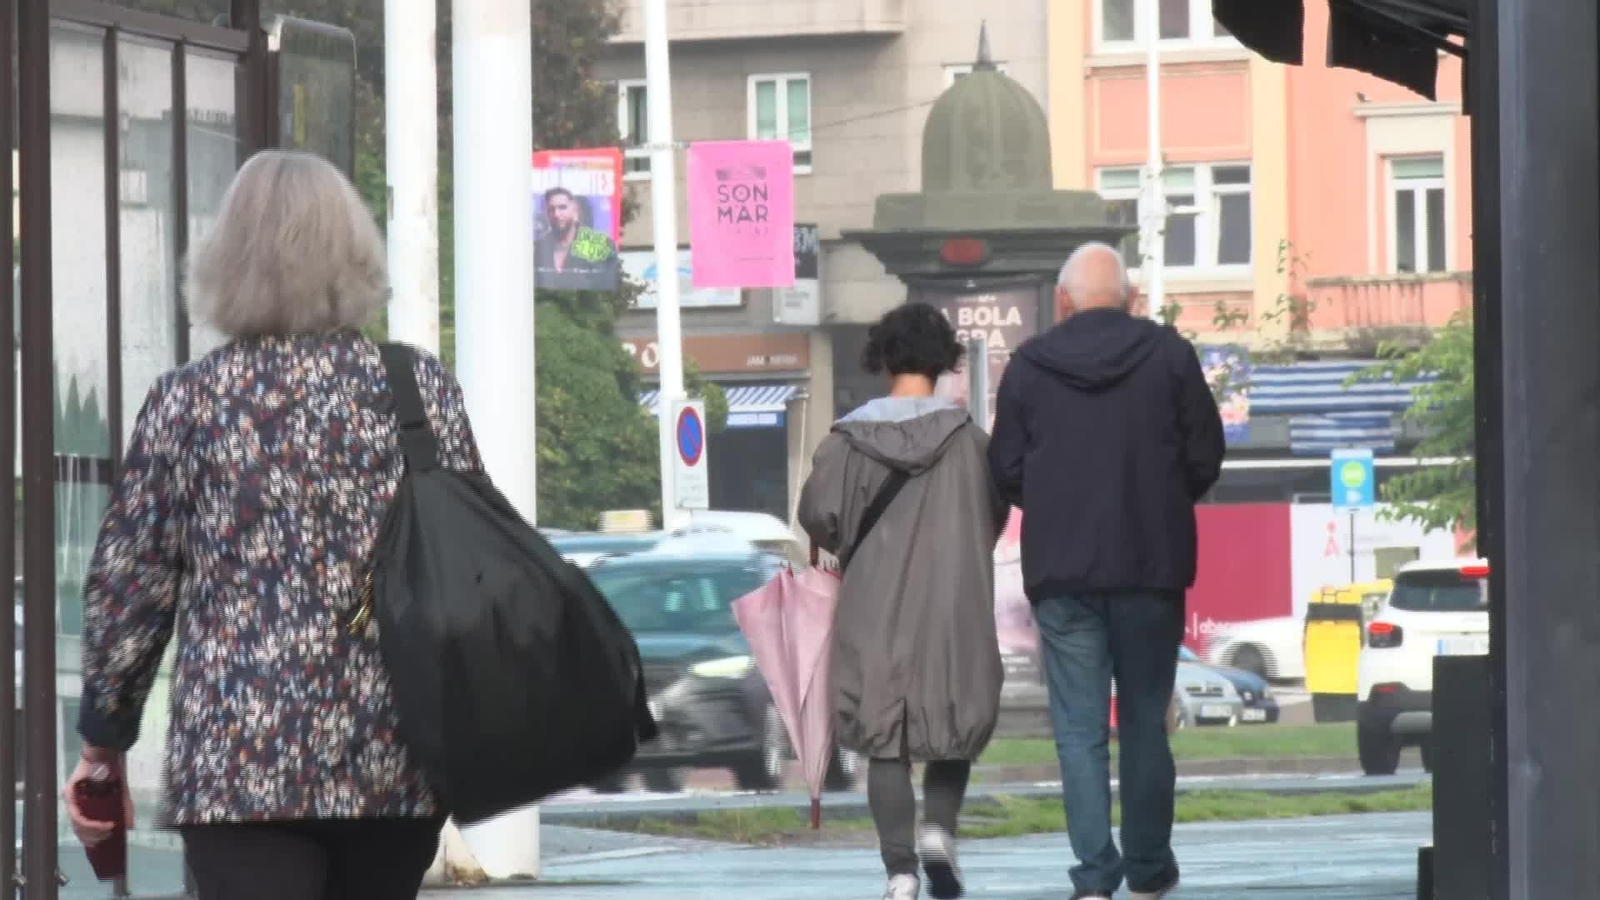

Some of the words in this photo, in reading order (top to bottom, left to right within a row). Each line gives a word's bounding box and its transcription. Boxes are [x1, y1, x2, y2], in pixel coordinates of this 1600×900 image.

[717, 184, 768, 203] SON
[717, 205, 769, 225] MAR
[957, 306, 1022, 327] BOLA
